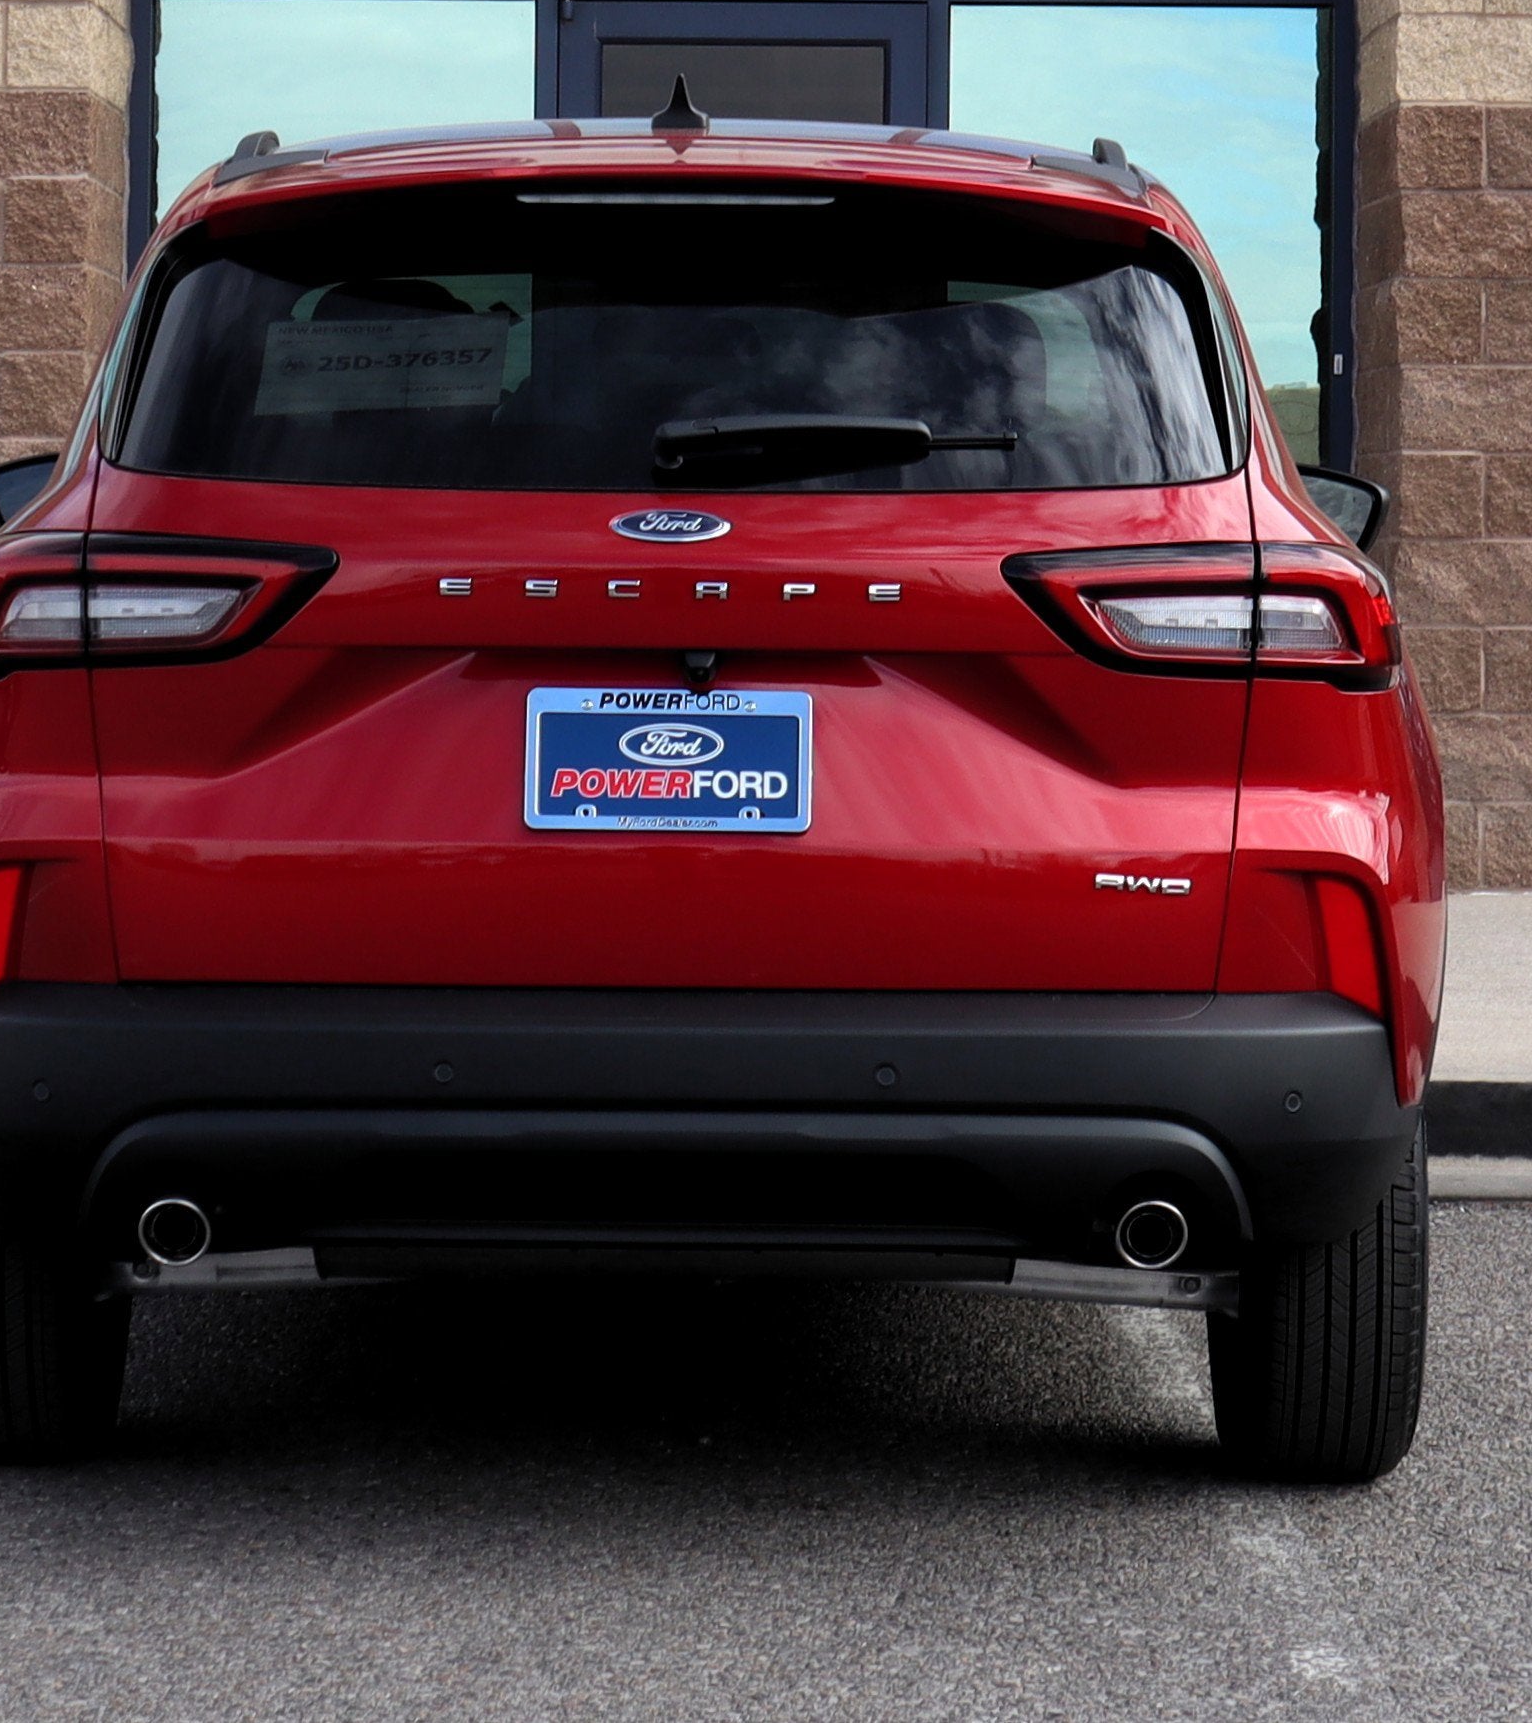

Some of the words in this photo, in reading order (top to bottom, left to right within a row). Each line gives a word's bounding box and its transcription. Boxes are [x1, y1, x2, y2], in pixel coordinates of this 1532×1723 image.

[317, 347, 492, 372] 25D-376357
[639, 512, 703, 532] Ford
[439, 577, 902, 602] ESCAPE
[639, 729, 703, 757] Ford
[1095, 873, 1191, 894] AWD
